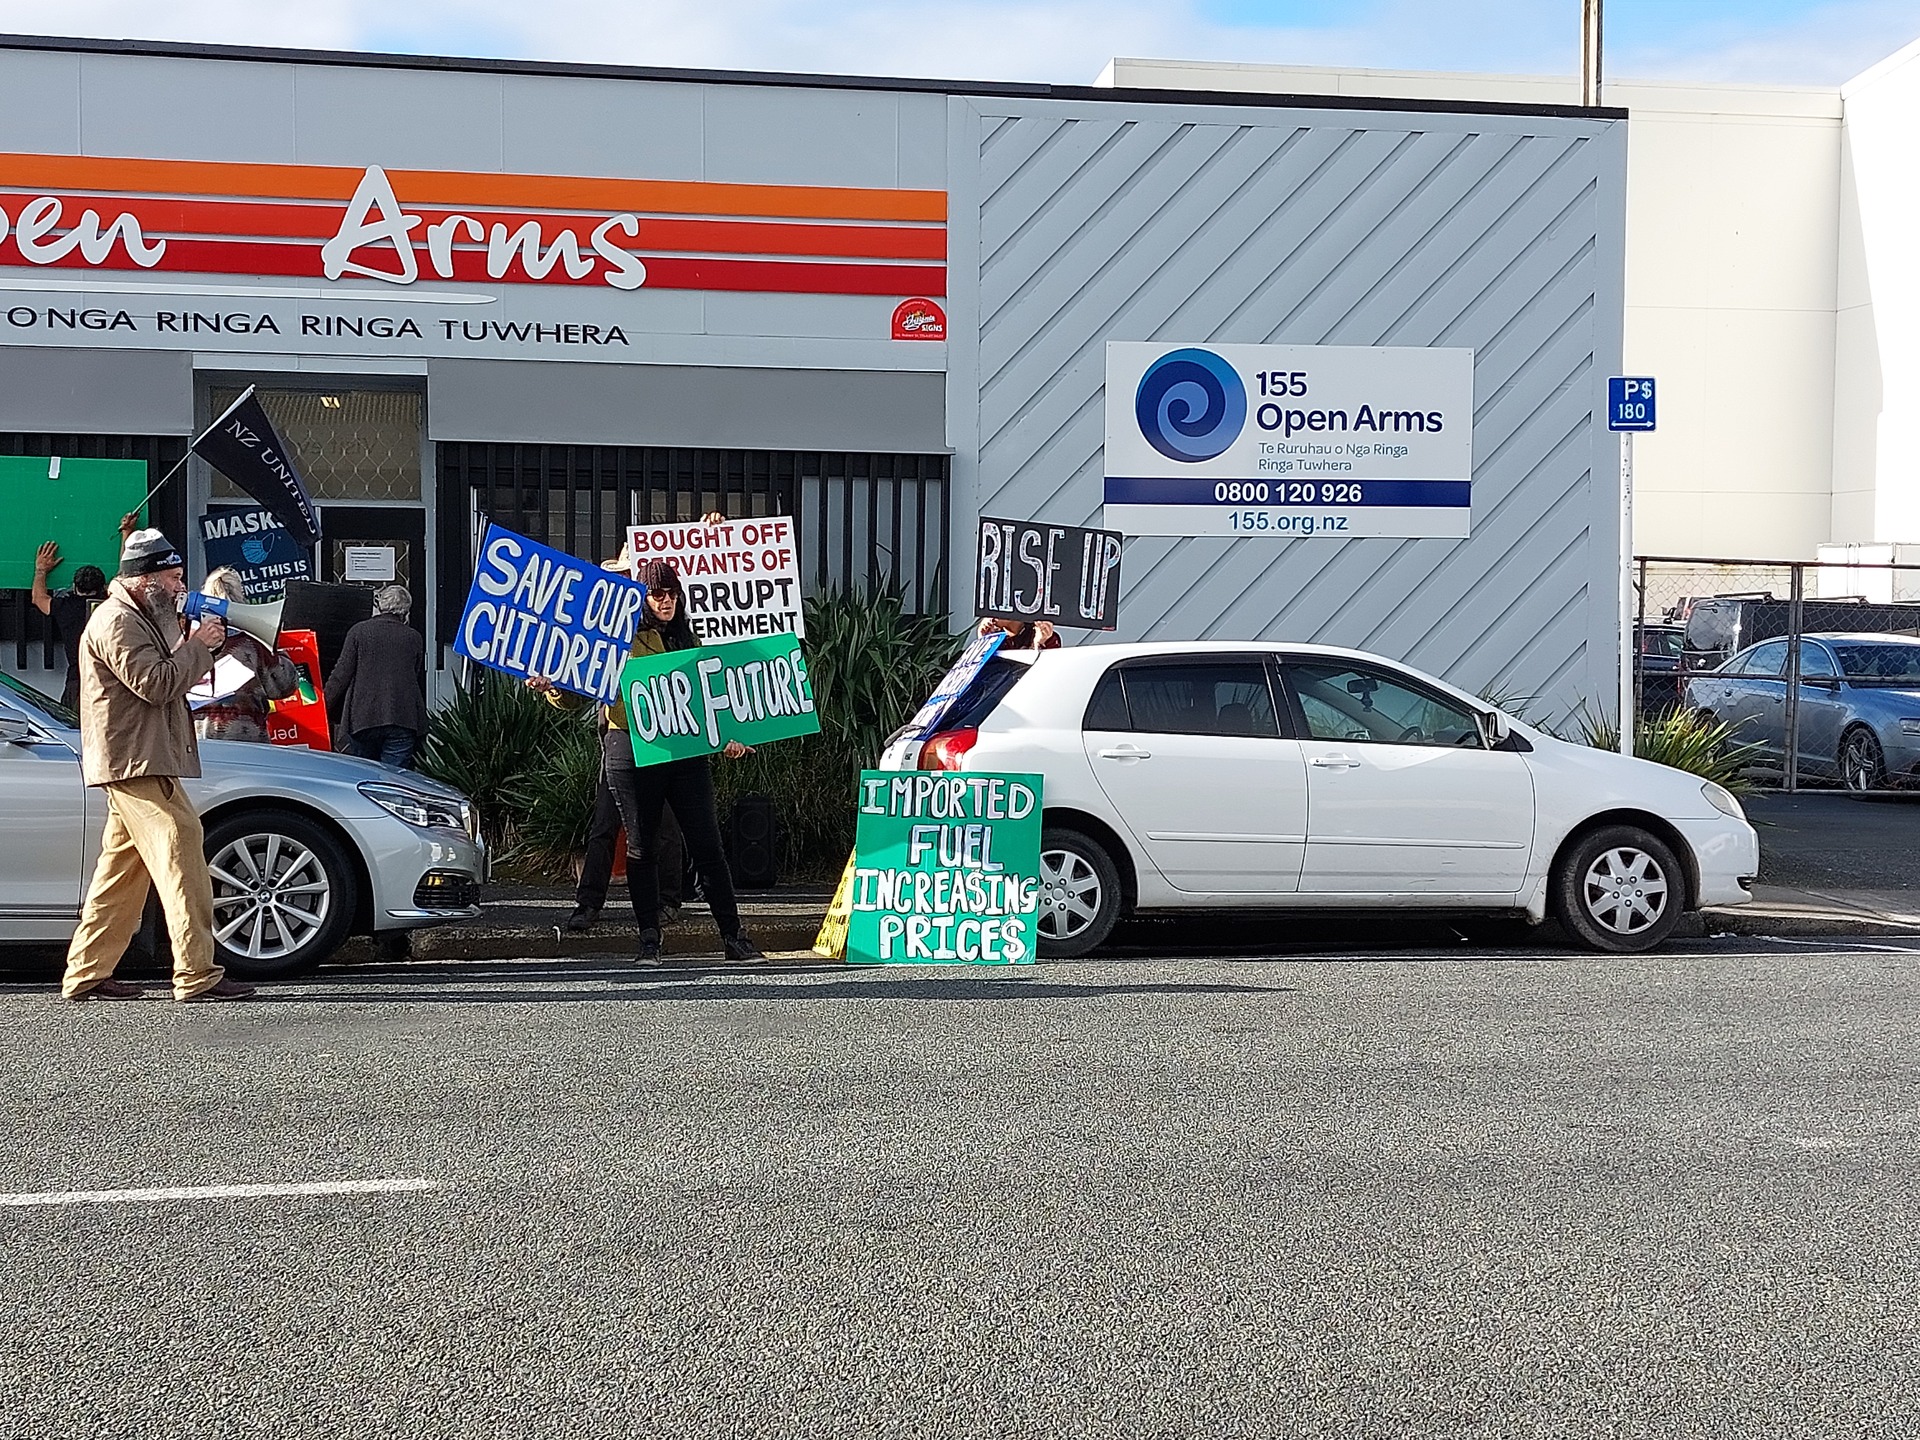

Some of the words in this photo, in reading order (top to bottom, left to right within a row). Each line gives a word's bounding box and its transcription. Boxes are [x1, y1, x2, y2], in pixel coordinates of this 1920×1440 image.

[320, 163, 647, 290] Arms
[7, 306, 37, 328] O
[47, 307, 137, 331] NGA
[156, 310, 281, 335] RINGA
[301, 315, 423, 339] RINGA
[438, 320, 630, 346] TUWHERA
[1256, 371, 1307, 397] 155
[1256, 403, 1348, 438] Open
[1352, 404, 1443, 433] Arms
[1618, 402, 1646, 420] 180
[225, 419, 261, 448] NZ
[1259, 442, 1274, 455] Te
[1277, 442, 1332, 455] Ruruhau
[1334, 445, 1343, 455] o
[1346, 443, 1371, 458] Nga
[1374, 443, 1409, 458] Ringa
[1258, 458, 1294, 473] Ringa
[1297, 459, 1352, 471] Tuwhera
[1214, 482, 1269, 502] 0800
[1275, 483, 1315, 502] 120
[1321, 483, 1362, 502] 926
[204, 511, 285, 540] MASK
[633, 526, 734, 553] BOUGHT
[741, 522, 788, 546] OFF
[1228, 511, 1349, 534] 155.org.nz
[259, 562, 291, 578] THIS
[293, 559, 307, 573] IS
[761, 548, 791, 572] OF
[979, 521, 1065, 616] RISE
[1079, 532, 1122, 620] UP
[478, 537, 583, 624] SAVE
[582, 578, 643, 644] OUR
[687, 577, 794, 614] RRUPT
[689, 611, 798, 639] ERNMENT
[464, 601, 629, 701] CHILDREN
[631, 670, 700, 743] OUR
[697, 649, 815, 748] FUTURE
[860, 776, 1036, 820] IMPORTED
[907, 824, 1005, 872] FUEL
